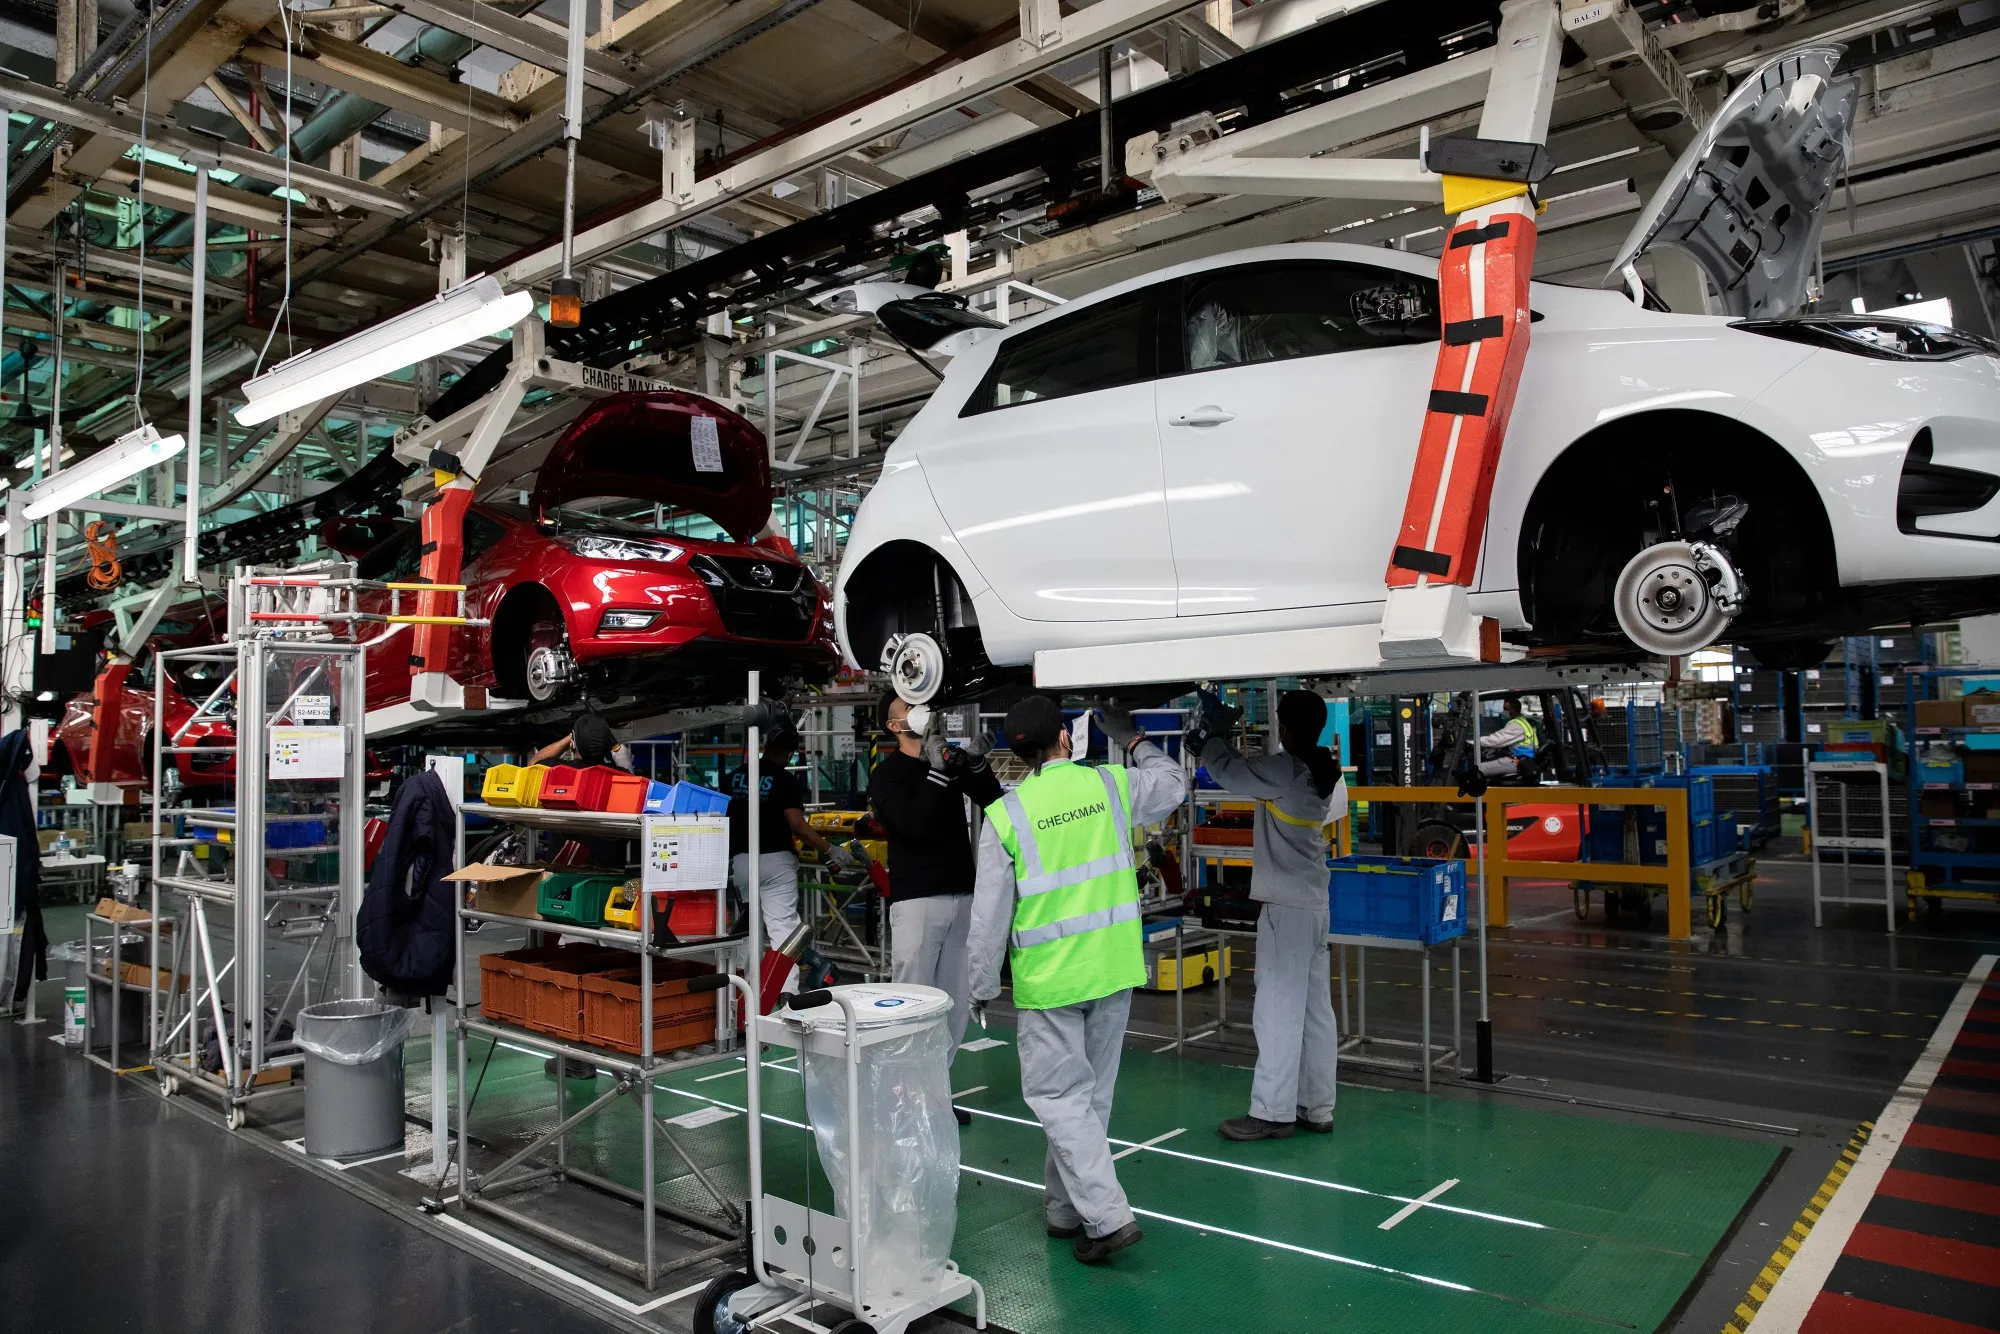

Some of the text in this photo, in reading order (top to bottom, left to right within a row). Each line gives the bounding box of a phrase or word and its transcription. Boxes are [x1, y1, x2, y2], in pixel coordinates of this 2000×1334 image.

[1574, 9, 1601, 24] BAL 31
[1641, 22, 1669, 86] CHARGE
[582, 367, 624, 392] CHARGE
[731, 773, 774, 791] FLS
[1037, 801, 1106, 830] CHECKMAN
